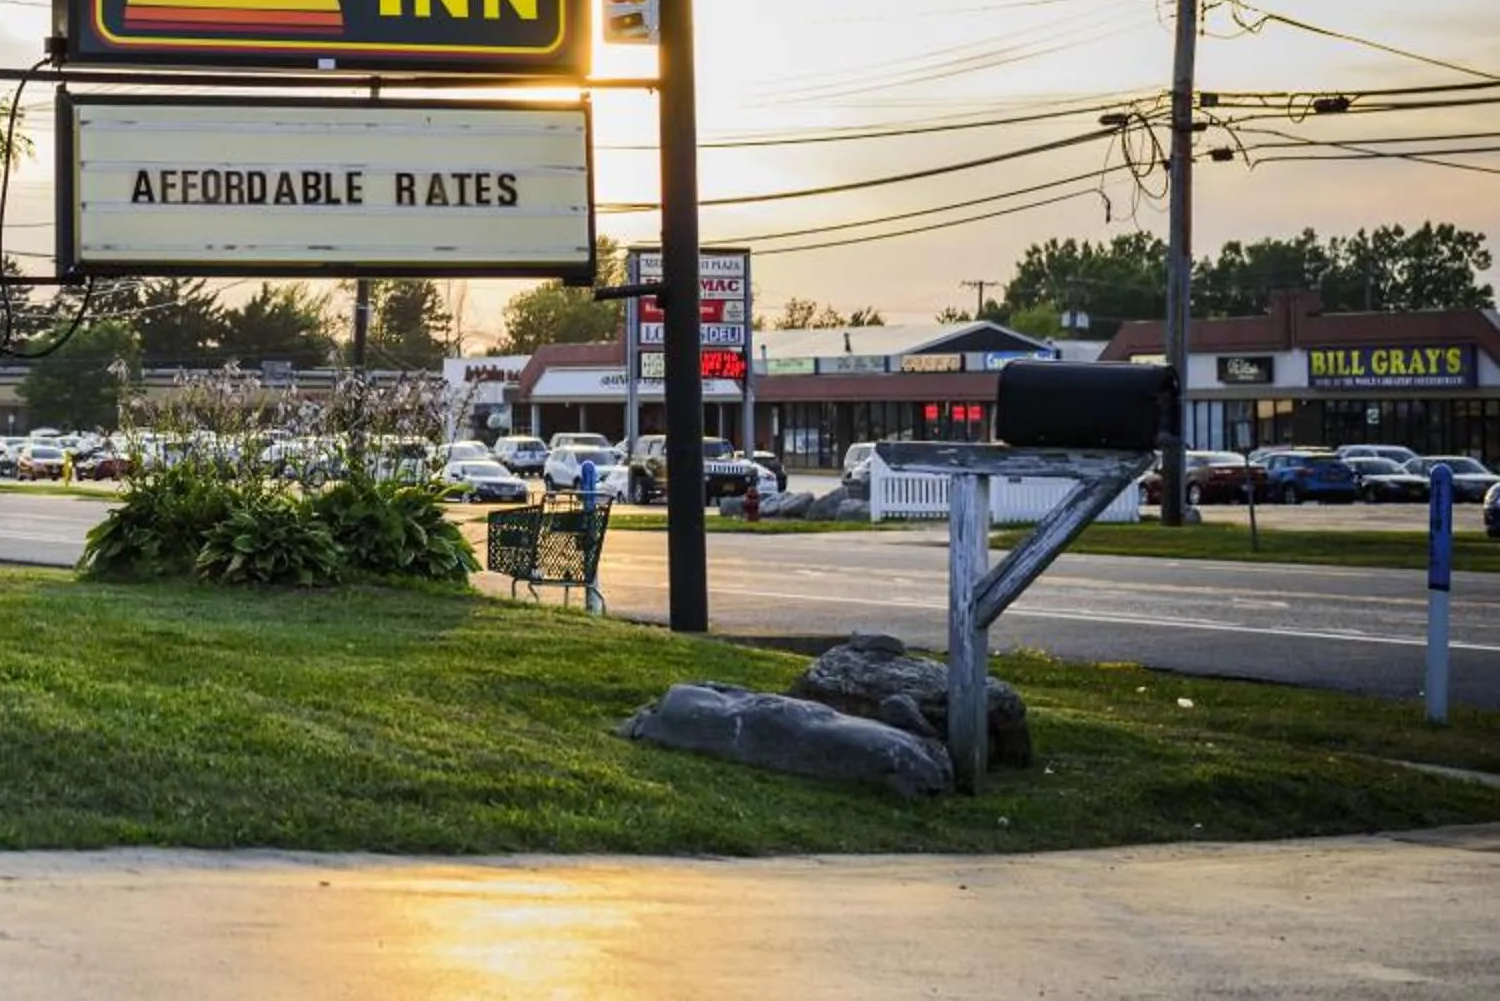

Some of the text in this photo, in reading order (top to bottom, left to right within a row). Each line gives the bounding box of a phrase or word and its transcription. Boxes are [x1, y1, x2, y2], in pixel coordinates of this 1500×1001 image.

[132, 169, 518, 206] AFFORDABLE RATES
[709, 328, 739, 341] DELI
[1310, 347, 1461, 376] BILL GRAY'S
